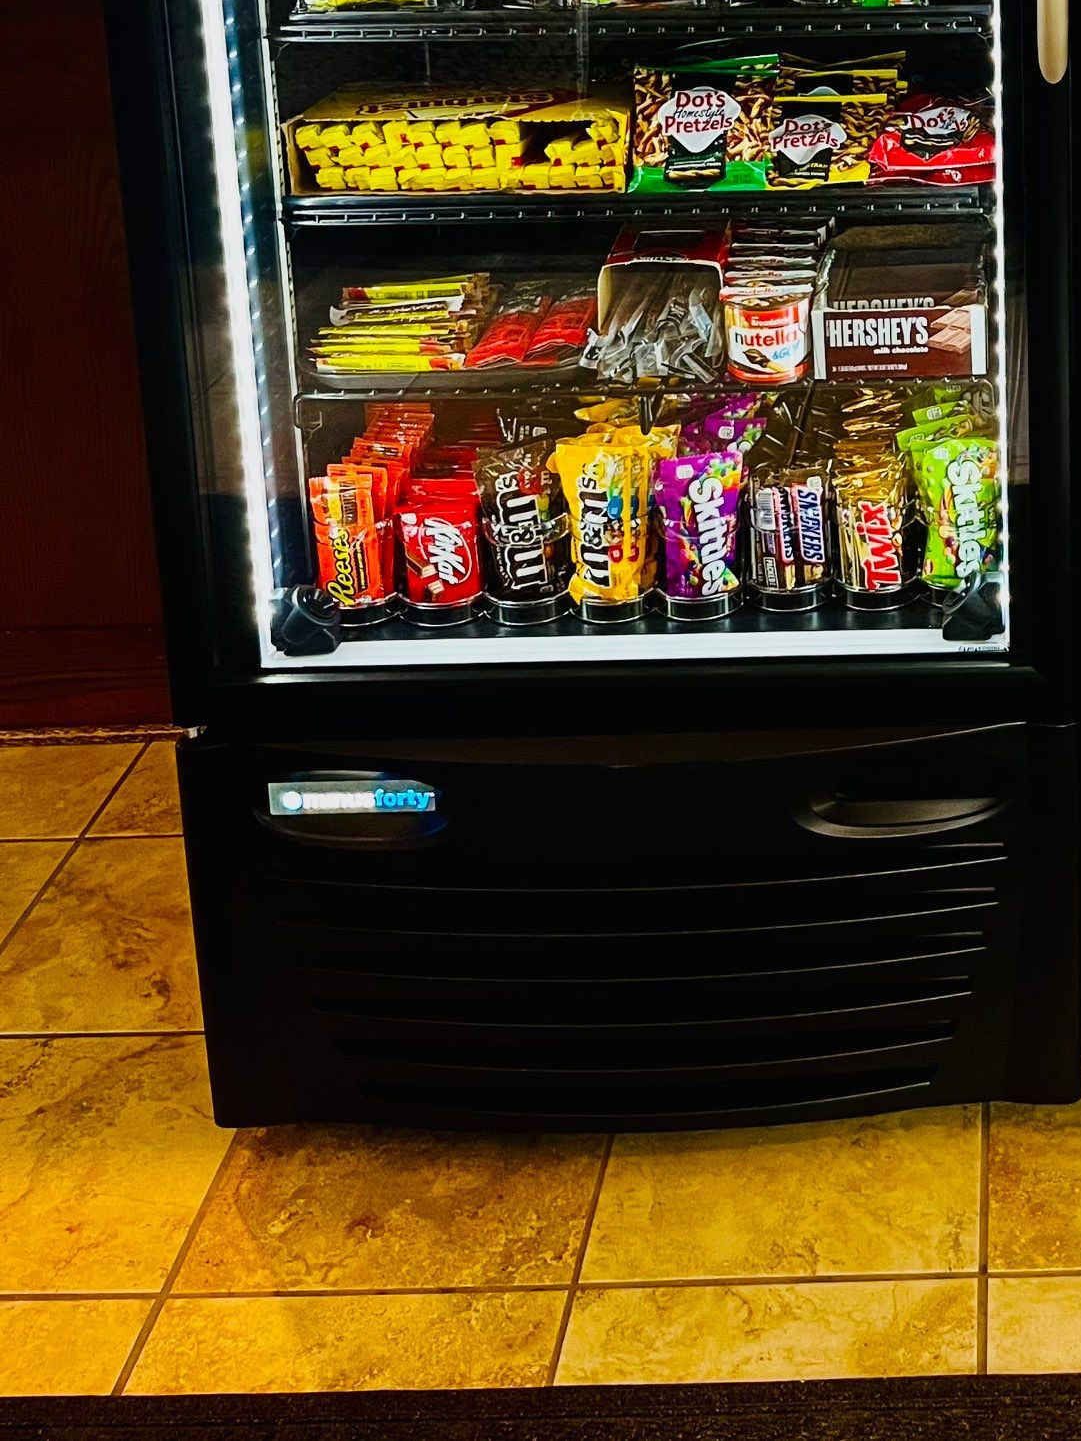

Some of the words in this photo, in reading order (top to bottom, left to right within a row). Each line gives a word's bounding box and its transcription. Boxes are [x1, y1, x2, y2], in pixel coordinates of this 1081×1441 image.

[676, 90, 726, 109] Dot's
[673, 106, 726, 122] Homestyle
[664, 114, 733, 135] Pretzels
[784, 118, 834, 133] Dot's
[771, 132, 840, 150] Pretzels
[733, 328, 799, 347] nutella
[828, 316, 930, 348] HERSHEY'S
[688, 475, 728, 597] Skittles
